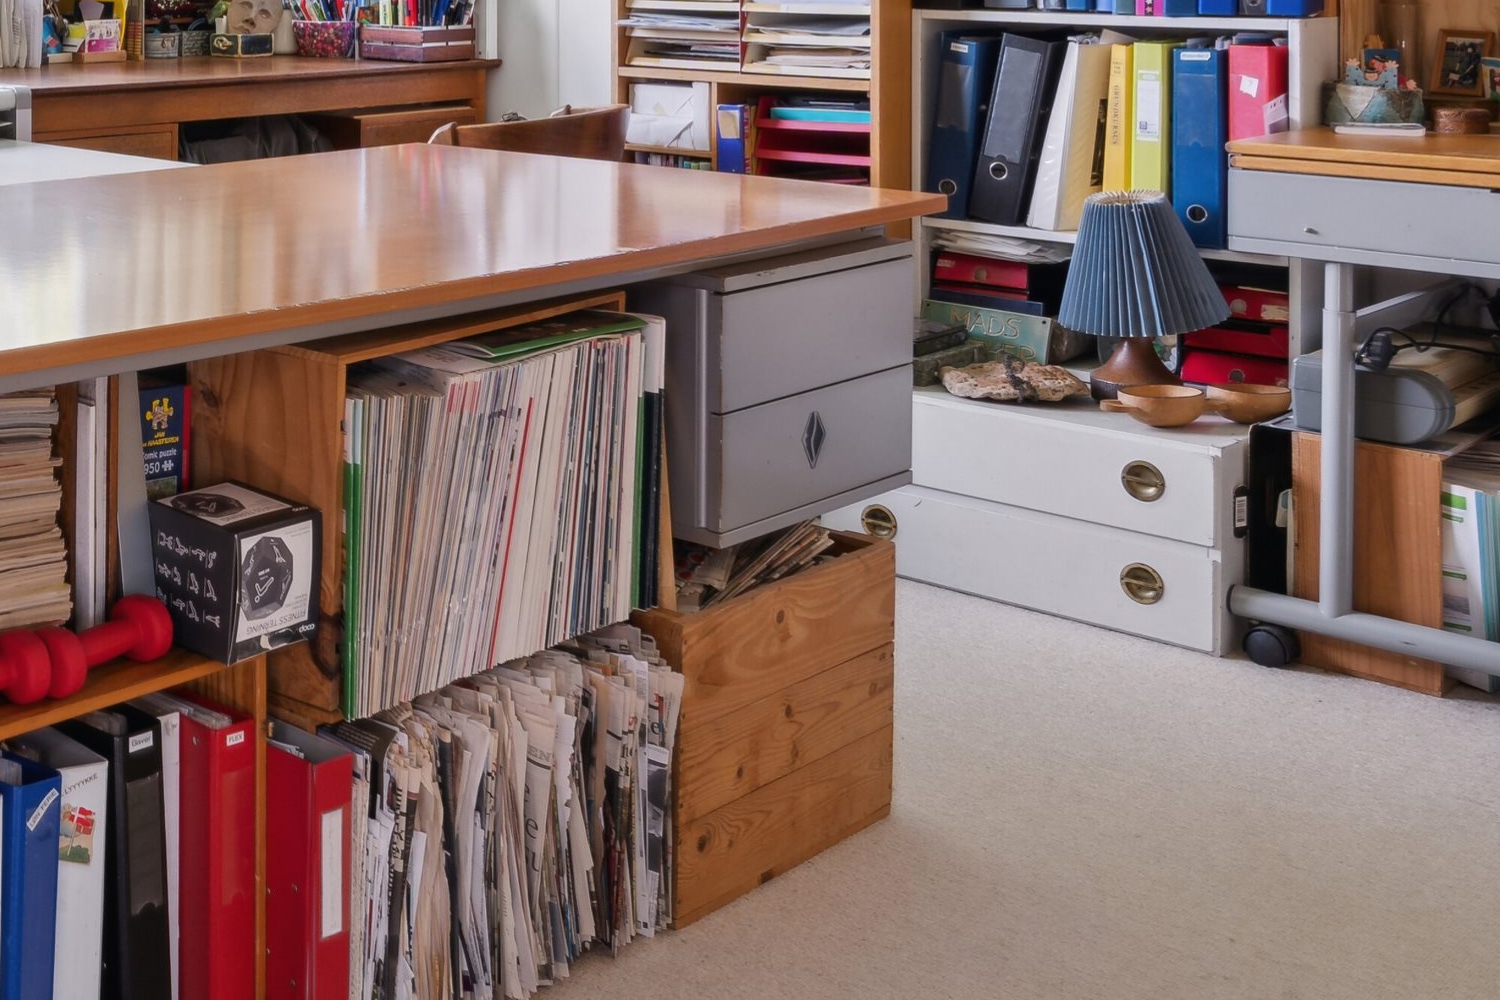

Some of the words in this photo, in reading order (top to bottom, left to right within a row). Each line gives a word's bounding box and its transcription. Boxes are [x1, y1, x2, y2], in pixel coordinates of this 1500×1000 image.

[950, 309, 1021, 340] MADS
[154, 431, 166, 439] JAN
[143, 450, 158, 460] omic
[158, 447, 177, 459] puzzle
[143, 461, 160, 475] 950
[299, 623, 316, 633] coop
[228, 734, 243, 744] FLEX
